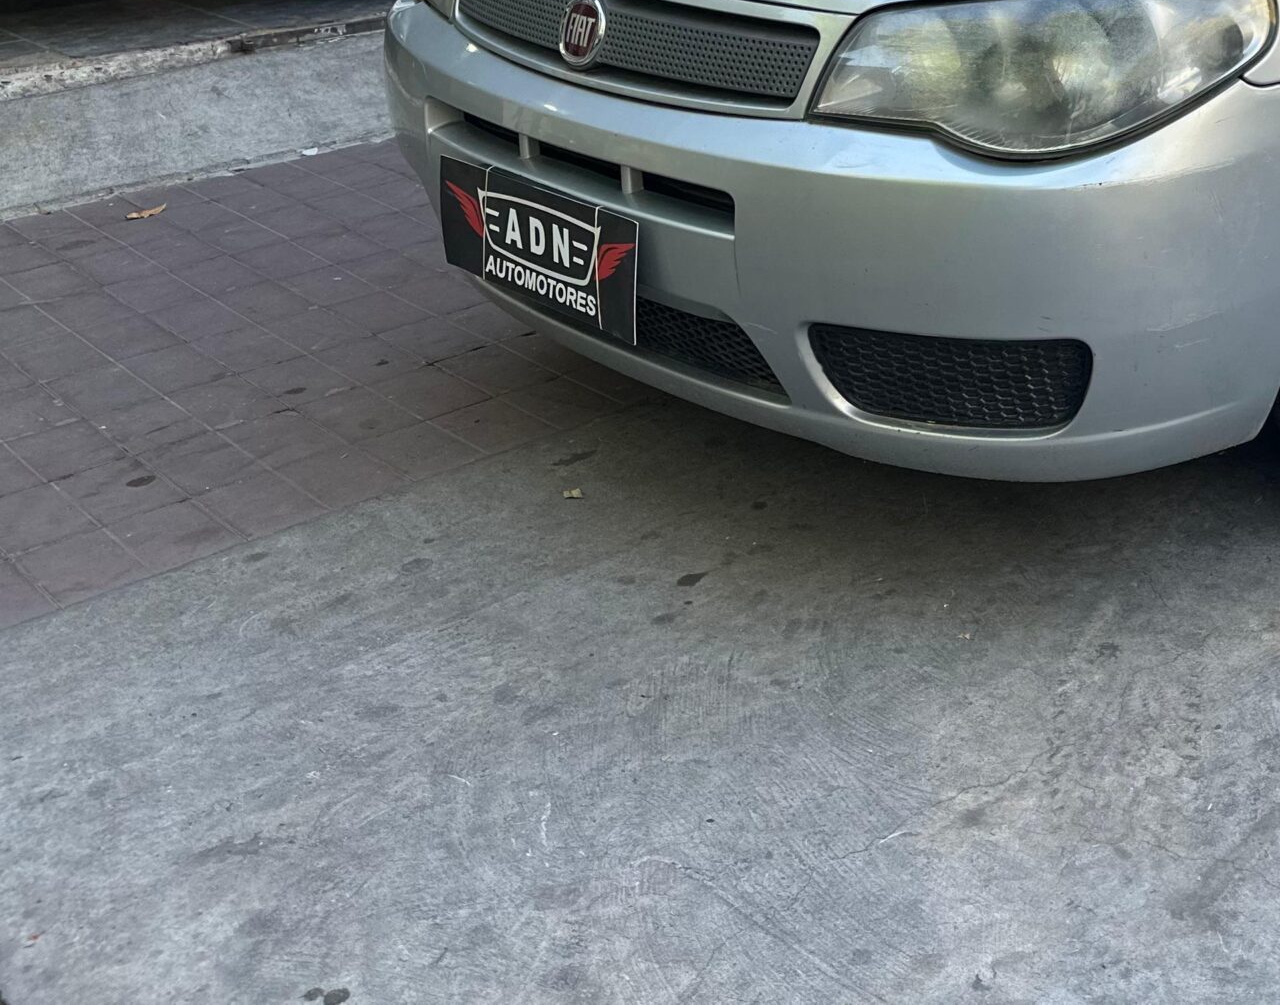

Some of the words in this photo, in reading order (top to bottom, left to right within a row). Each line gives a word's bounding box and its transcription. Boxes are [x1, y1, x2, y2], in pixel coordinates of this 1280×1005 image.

[565, 13, 596, 48] FIAT
[505, 207, 570, 268] ADN
[485, 255, 597, 317] AUTOMOTORES
